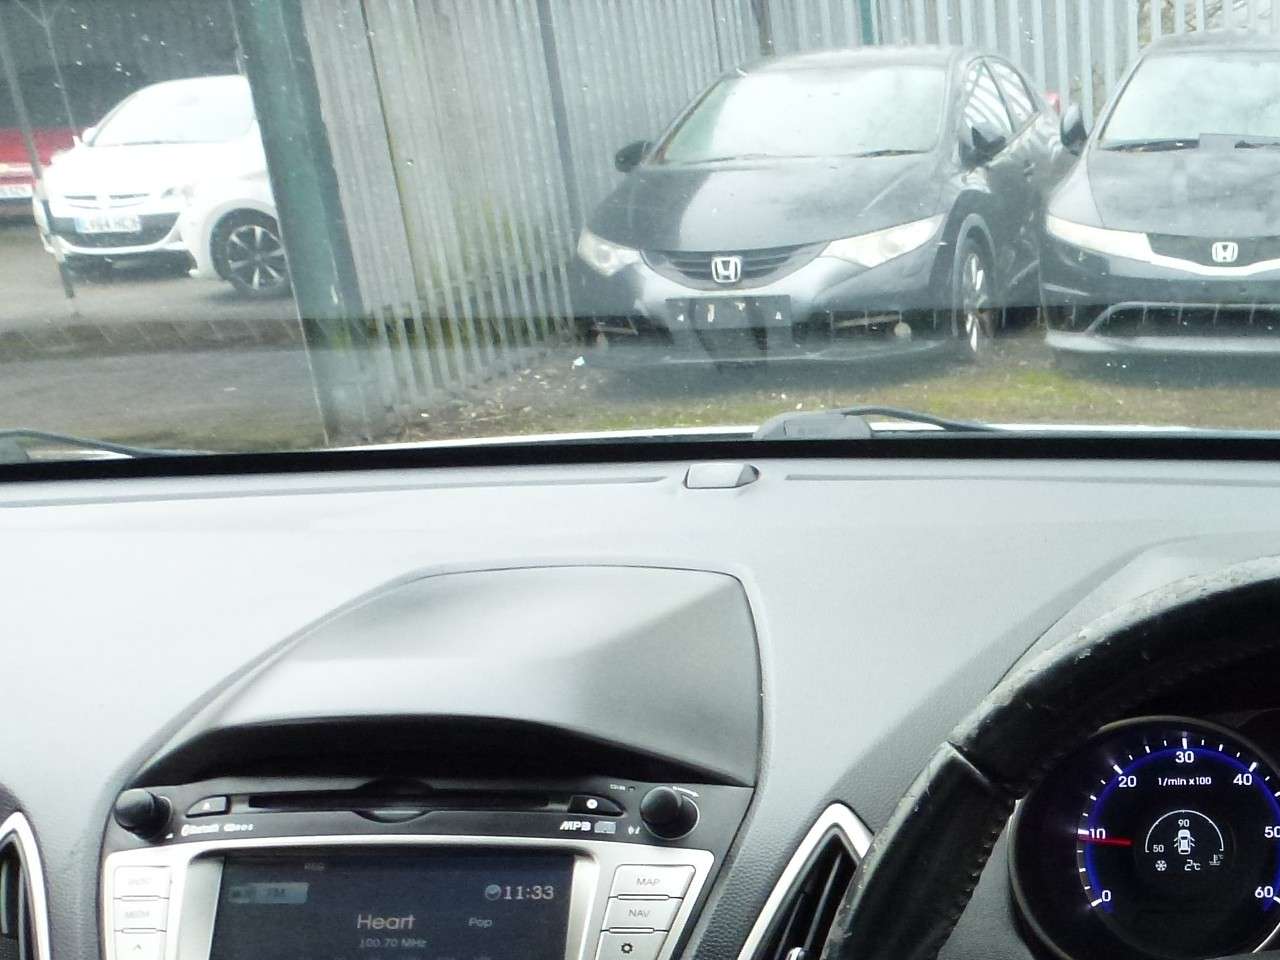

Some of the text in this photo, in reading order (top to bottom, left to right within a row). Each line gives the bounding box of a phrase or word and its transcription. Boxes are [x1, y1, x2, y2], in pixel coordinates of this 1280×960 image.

[1176, 752, 1194, 763] 30
[1118, 776, 1137, 787] 20
[1158, 777, 1212, 786] 1/min x100
[1233, 774, 1252, 785] 40
[1178, 819, 1190, 827] 90
[1092, 829, 1106, 840] 10
[1153, 844, 1164, 853] 50
[636, 877, 660, 886] MAP
[503, 885, 555, 900] 11:33
[1102, 890, 1112, 902] 0
[1255, 886, 1273, 898] 60
[628, 909, 650, 918] NAV
[357, 914, 416, 930] Heart
[468, 917, 493, 928] Pop
[401, 938, 427, 948] MHz
